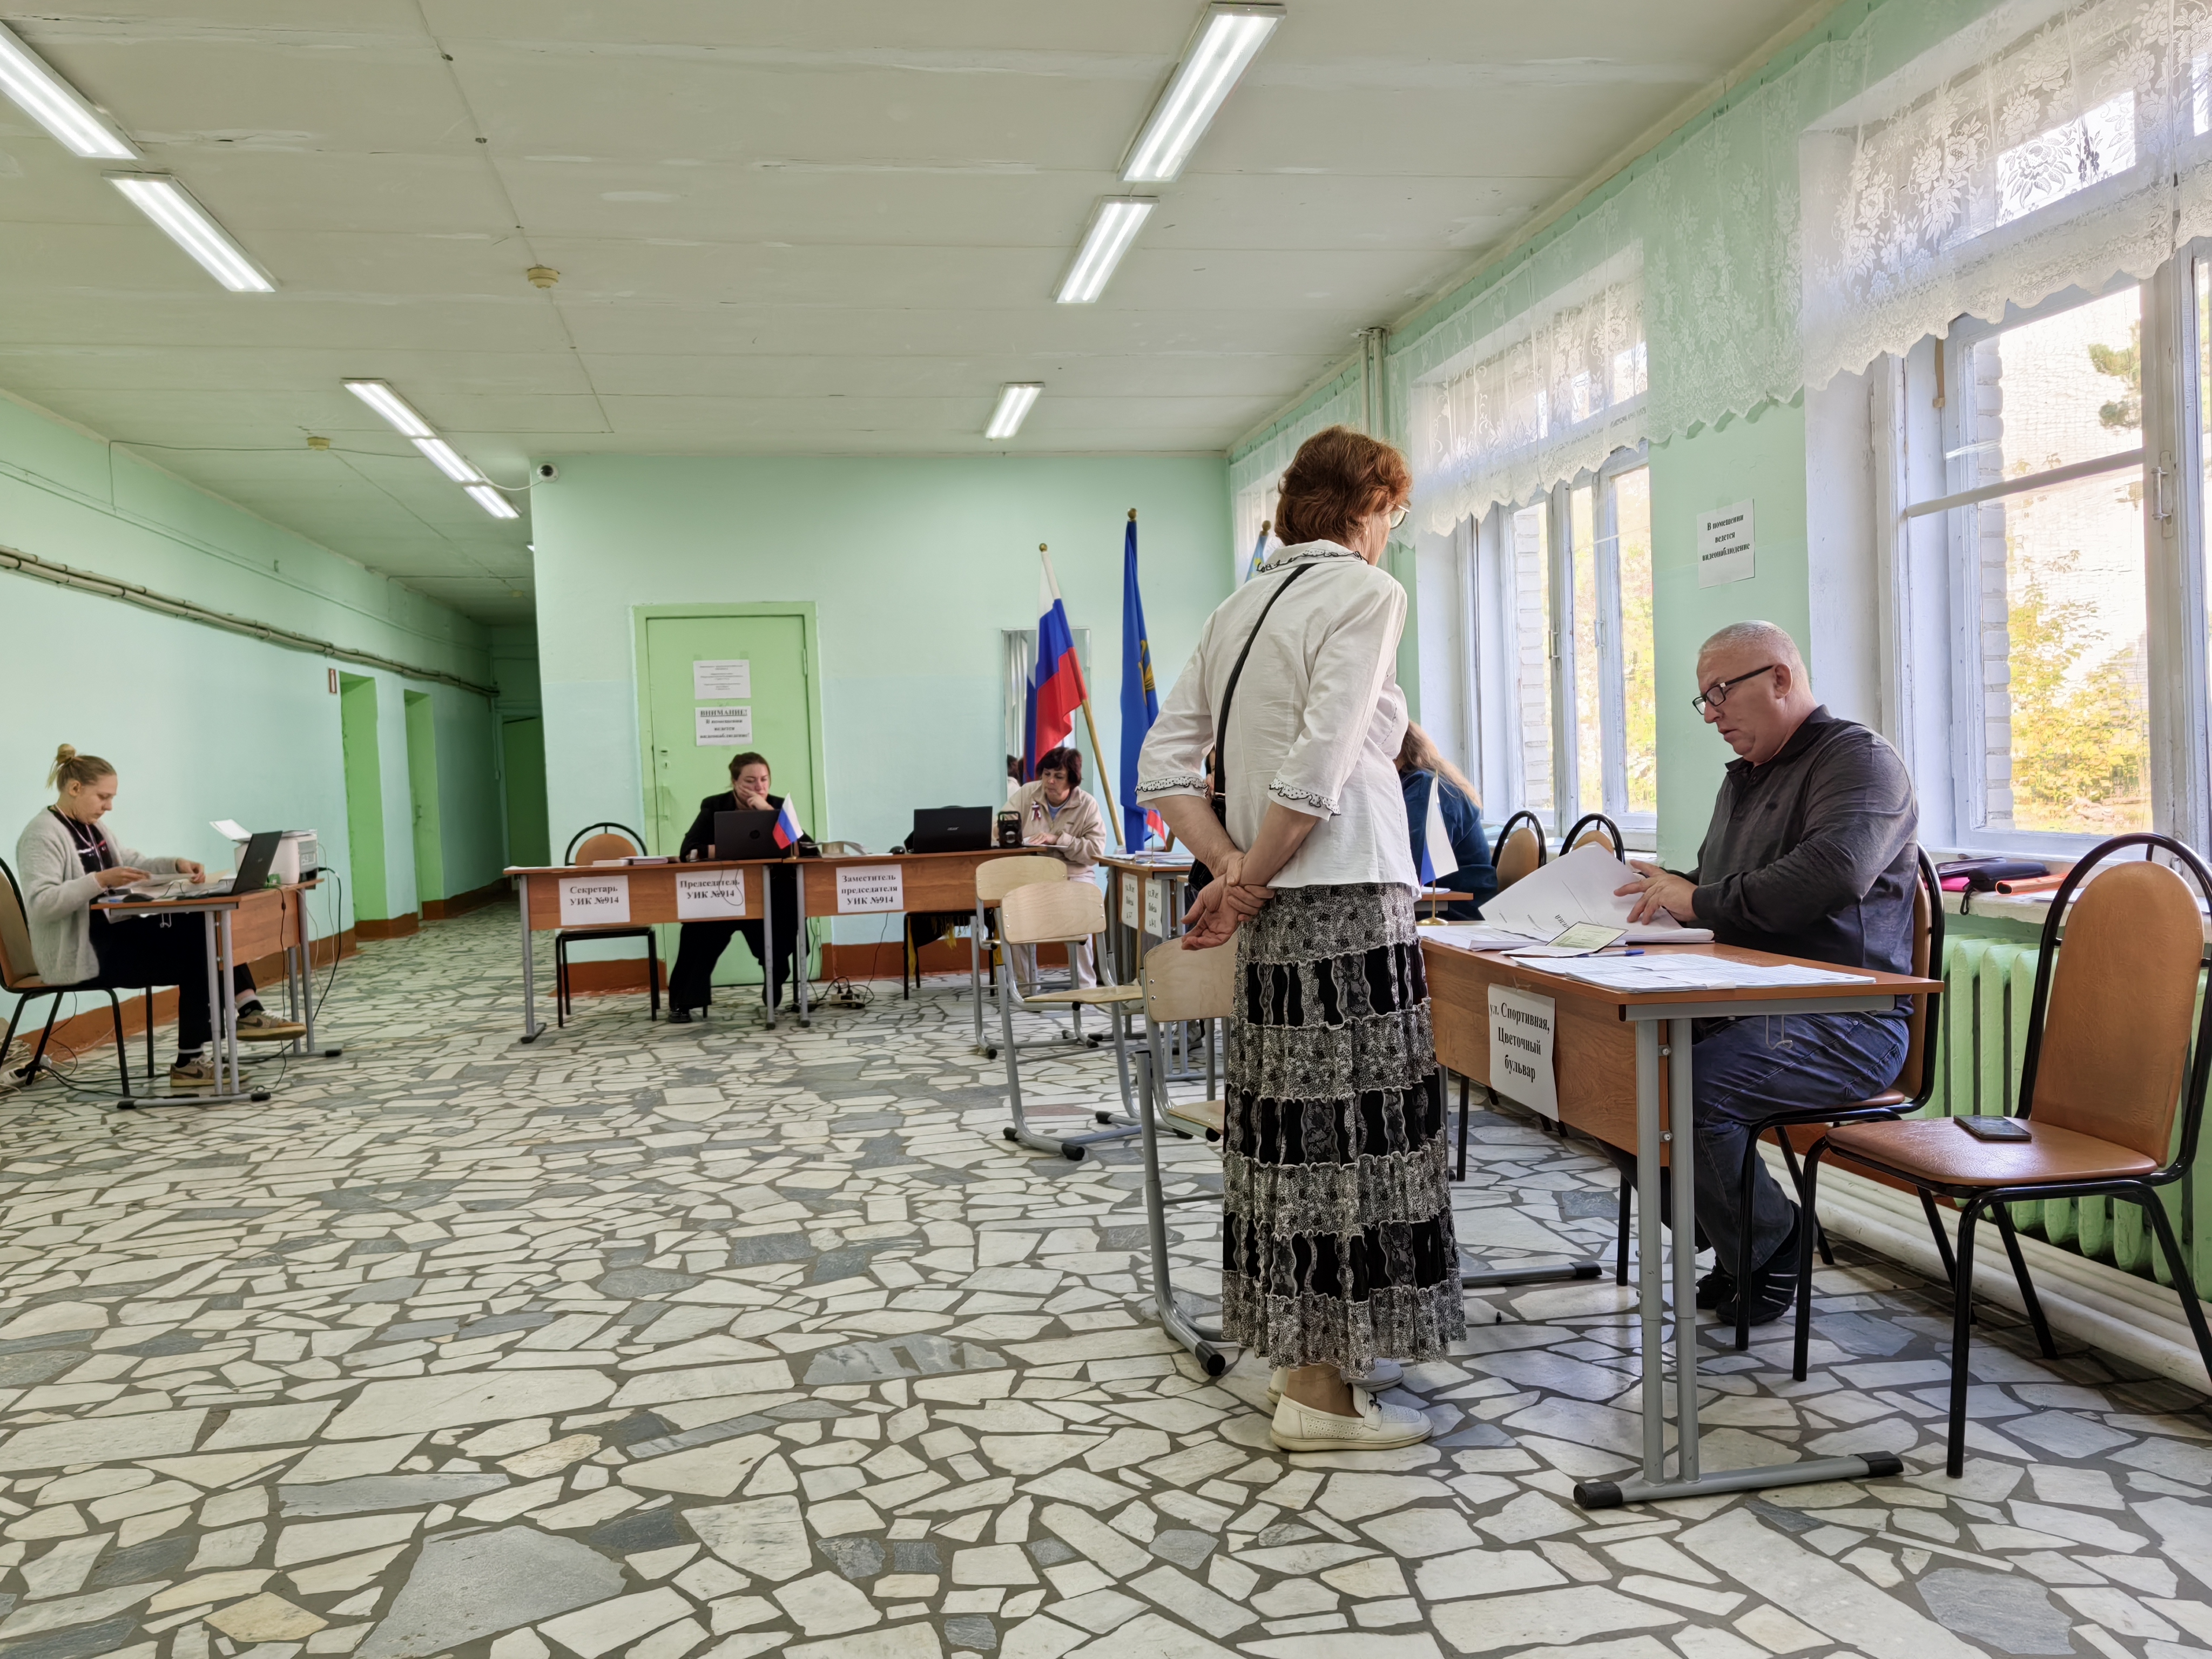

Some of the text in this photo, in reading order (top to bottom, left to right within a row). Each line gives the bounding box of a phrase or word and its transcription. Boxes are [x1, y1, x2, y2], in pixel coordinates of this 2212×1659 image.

[1707, 522, 1711, 531] В
[680, 880, 740, 889] Председатель
[570, 886, 618, 895] Секретарь
[687, 890, 734, 899] УИК №914
[841, 886, 897, 895] председателя
[570, 896, 619, 906] УИК №914
[847, 896, 893, 905] УИК №914
[1490, 1002, 1550, 1035] ул. Спортивная,
[1498, 1027, 1541, 1055] Цветочный
[1505, 1054, 1536, 1083] бульвар
